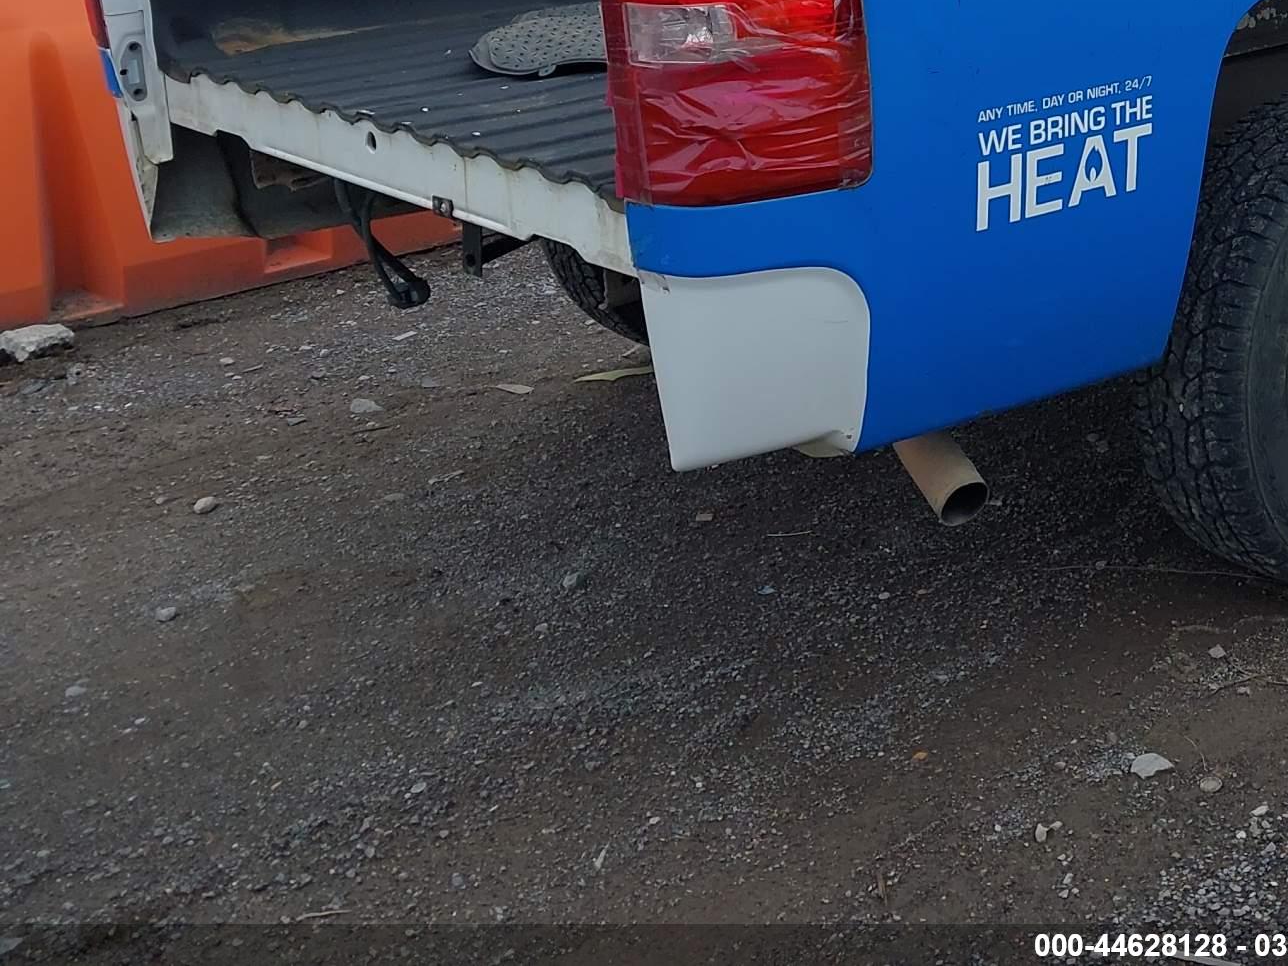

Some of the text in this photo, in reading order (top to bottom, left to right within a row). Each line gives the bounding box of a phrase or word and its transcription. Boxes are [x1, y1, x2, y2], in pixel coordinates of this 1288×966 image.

[977, 107, 1004, 123] ANY
[1042, 94, 1065, 110] DAY
[1068, 90, 1083, 104] OR
[1124, 75, 1152, 91] 24/7
[978, 95, 1153, 156] WE BRING THE
[976, 122, 1153, 232] HEAT
